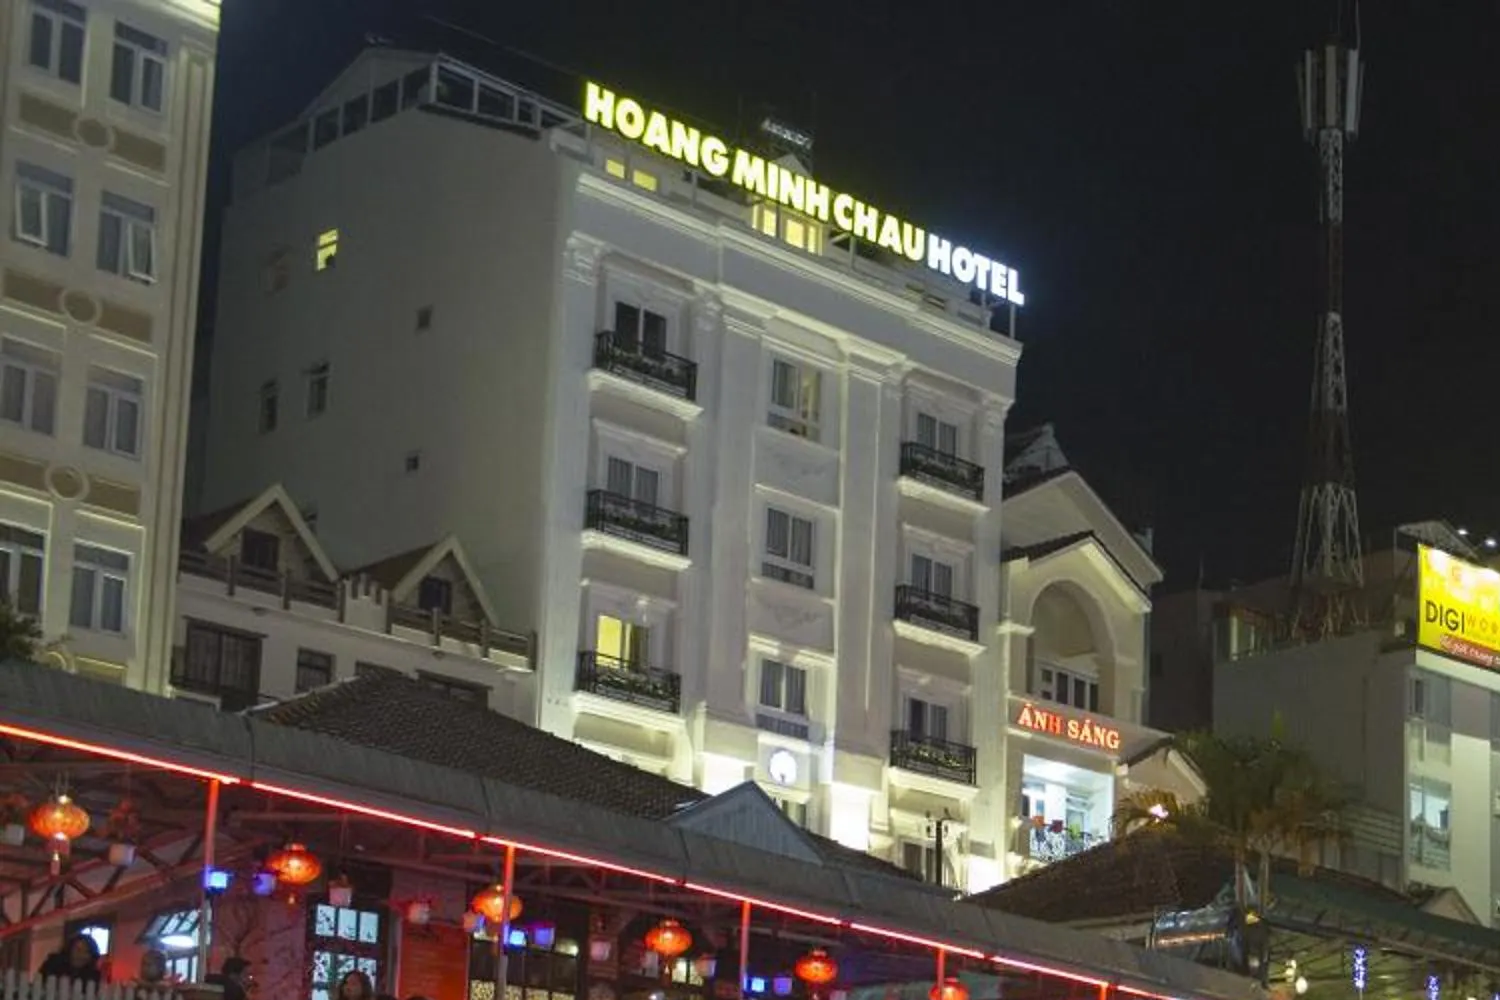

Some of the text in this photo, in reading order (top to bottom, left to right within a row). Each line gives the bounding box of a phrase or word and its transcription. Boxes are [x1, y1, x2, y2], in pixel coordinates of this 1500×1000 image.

[585, 81, 729, 177] HOANG
[731, 148, 830, 222] MINH
[833, 193, 926, 261] CHAU
[927, 233, 1025, 306] HOTEL
[1425, 600, 1465, 635] DIGI
